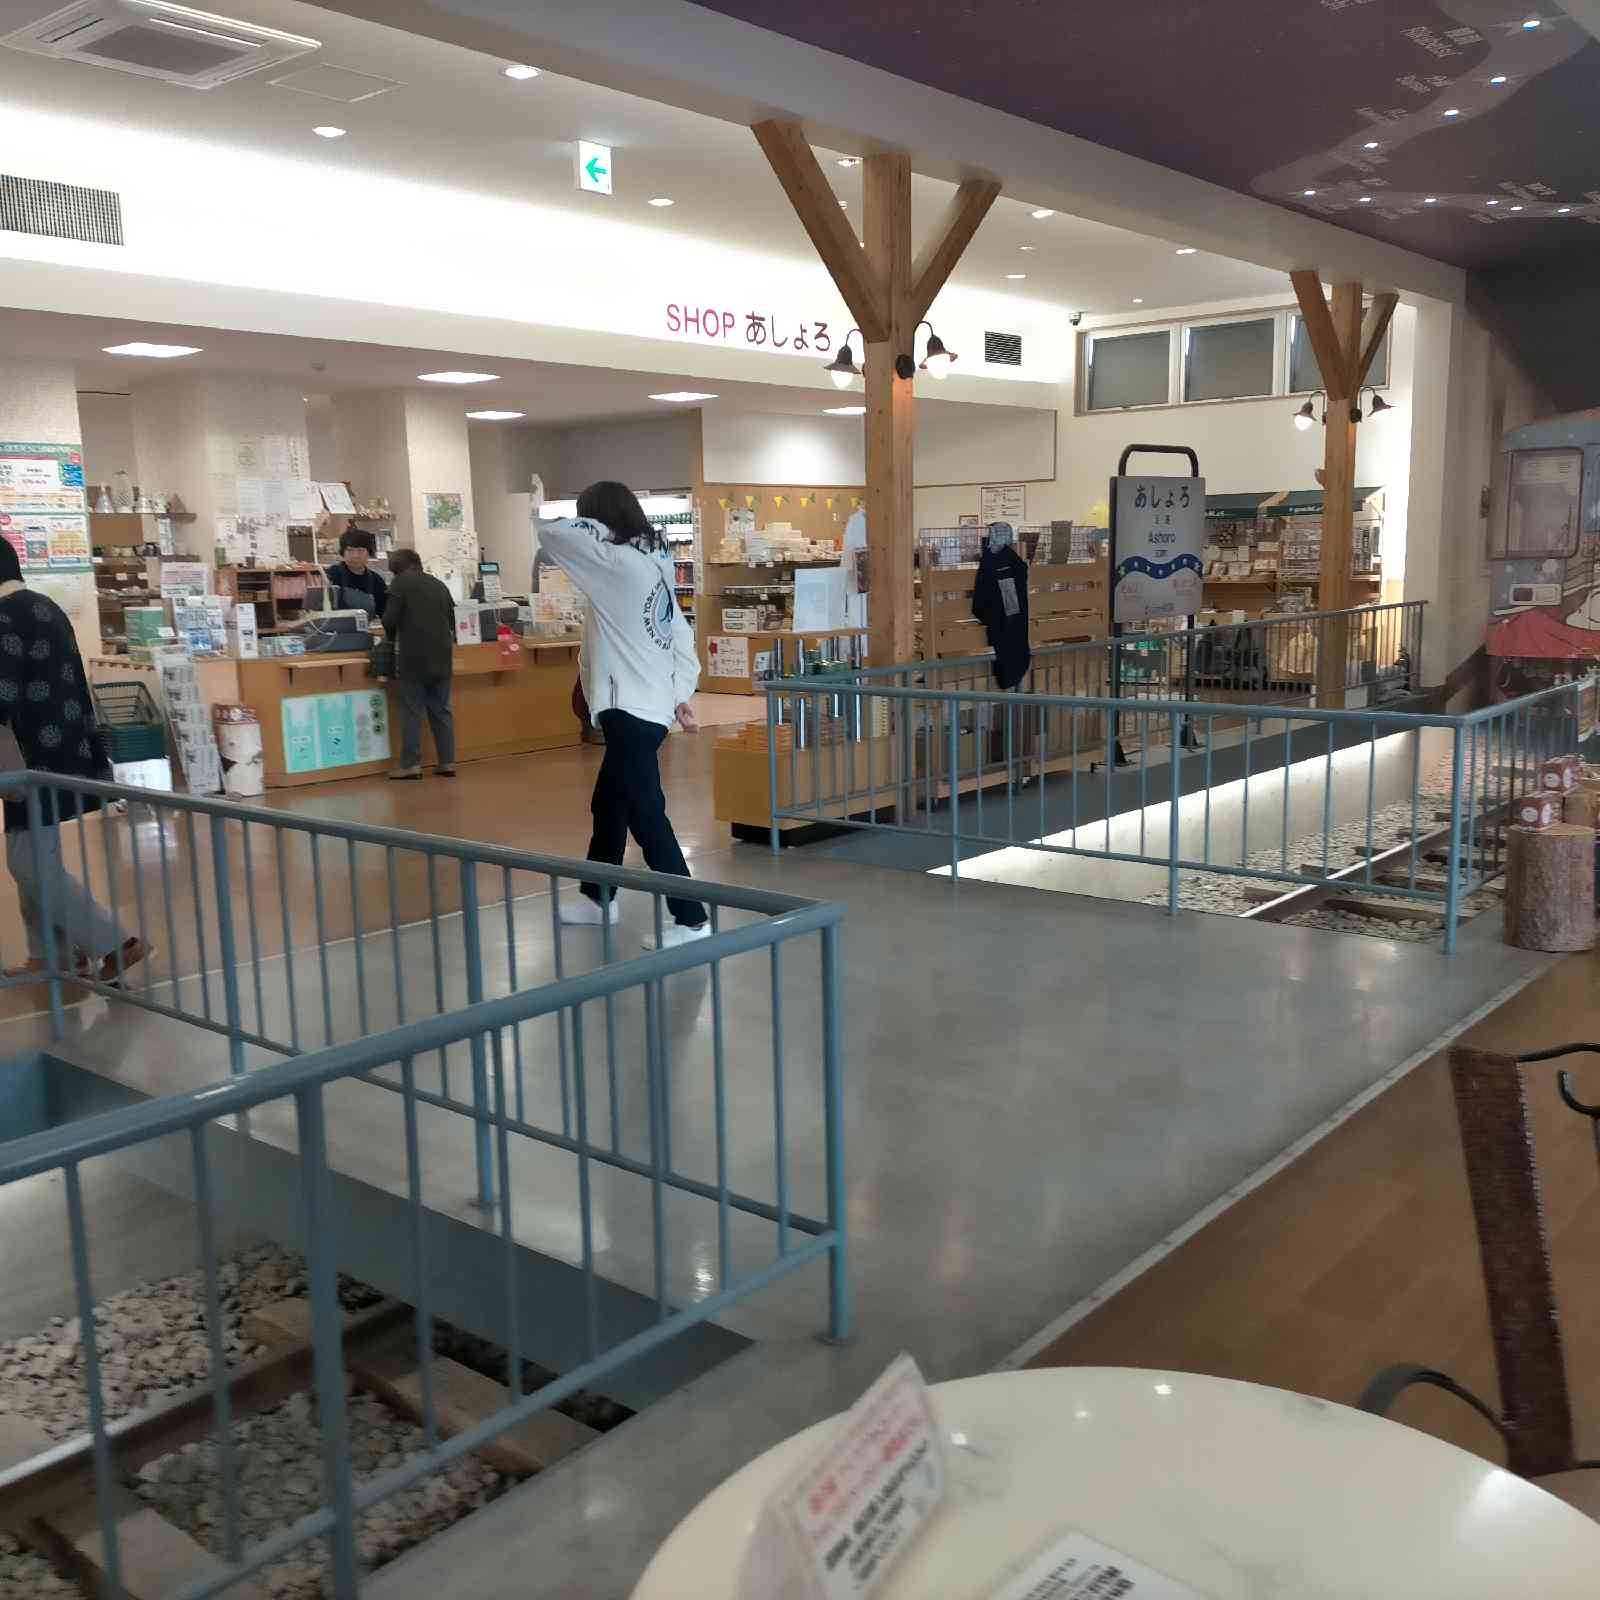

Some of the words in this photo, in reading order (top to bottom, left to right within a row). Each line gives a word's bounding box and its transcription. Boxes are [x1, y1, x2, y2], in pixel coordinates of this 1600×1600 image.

[667, 304, 735, 338] SHOP
[746, 311, 831, 351] あしょろ
[1135, 485, 1190, 508] あしょろ
